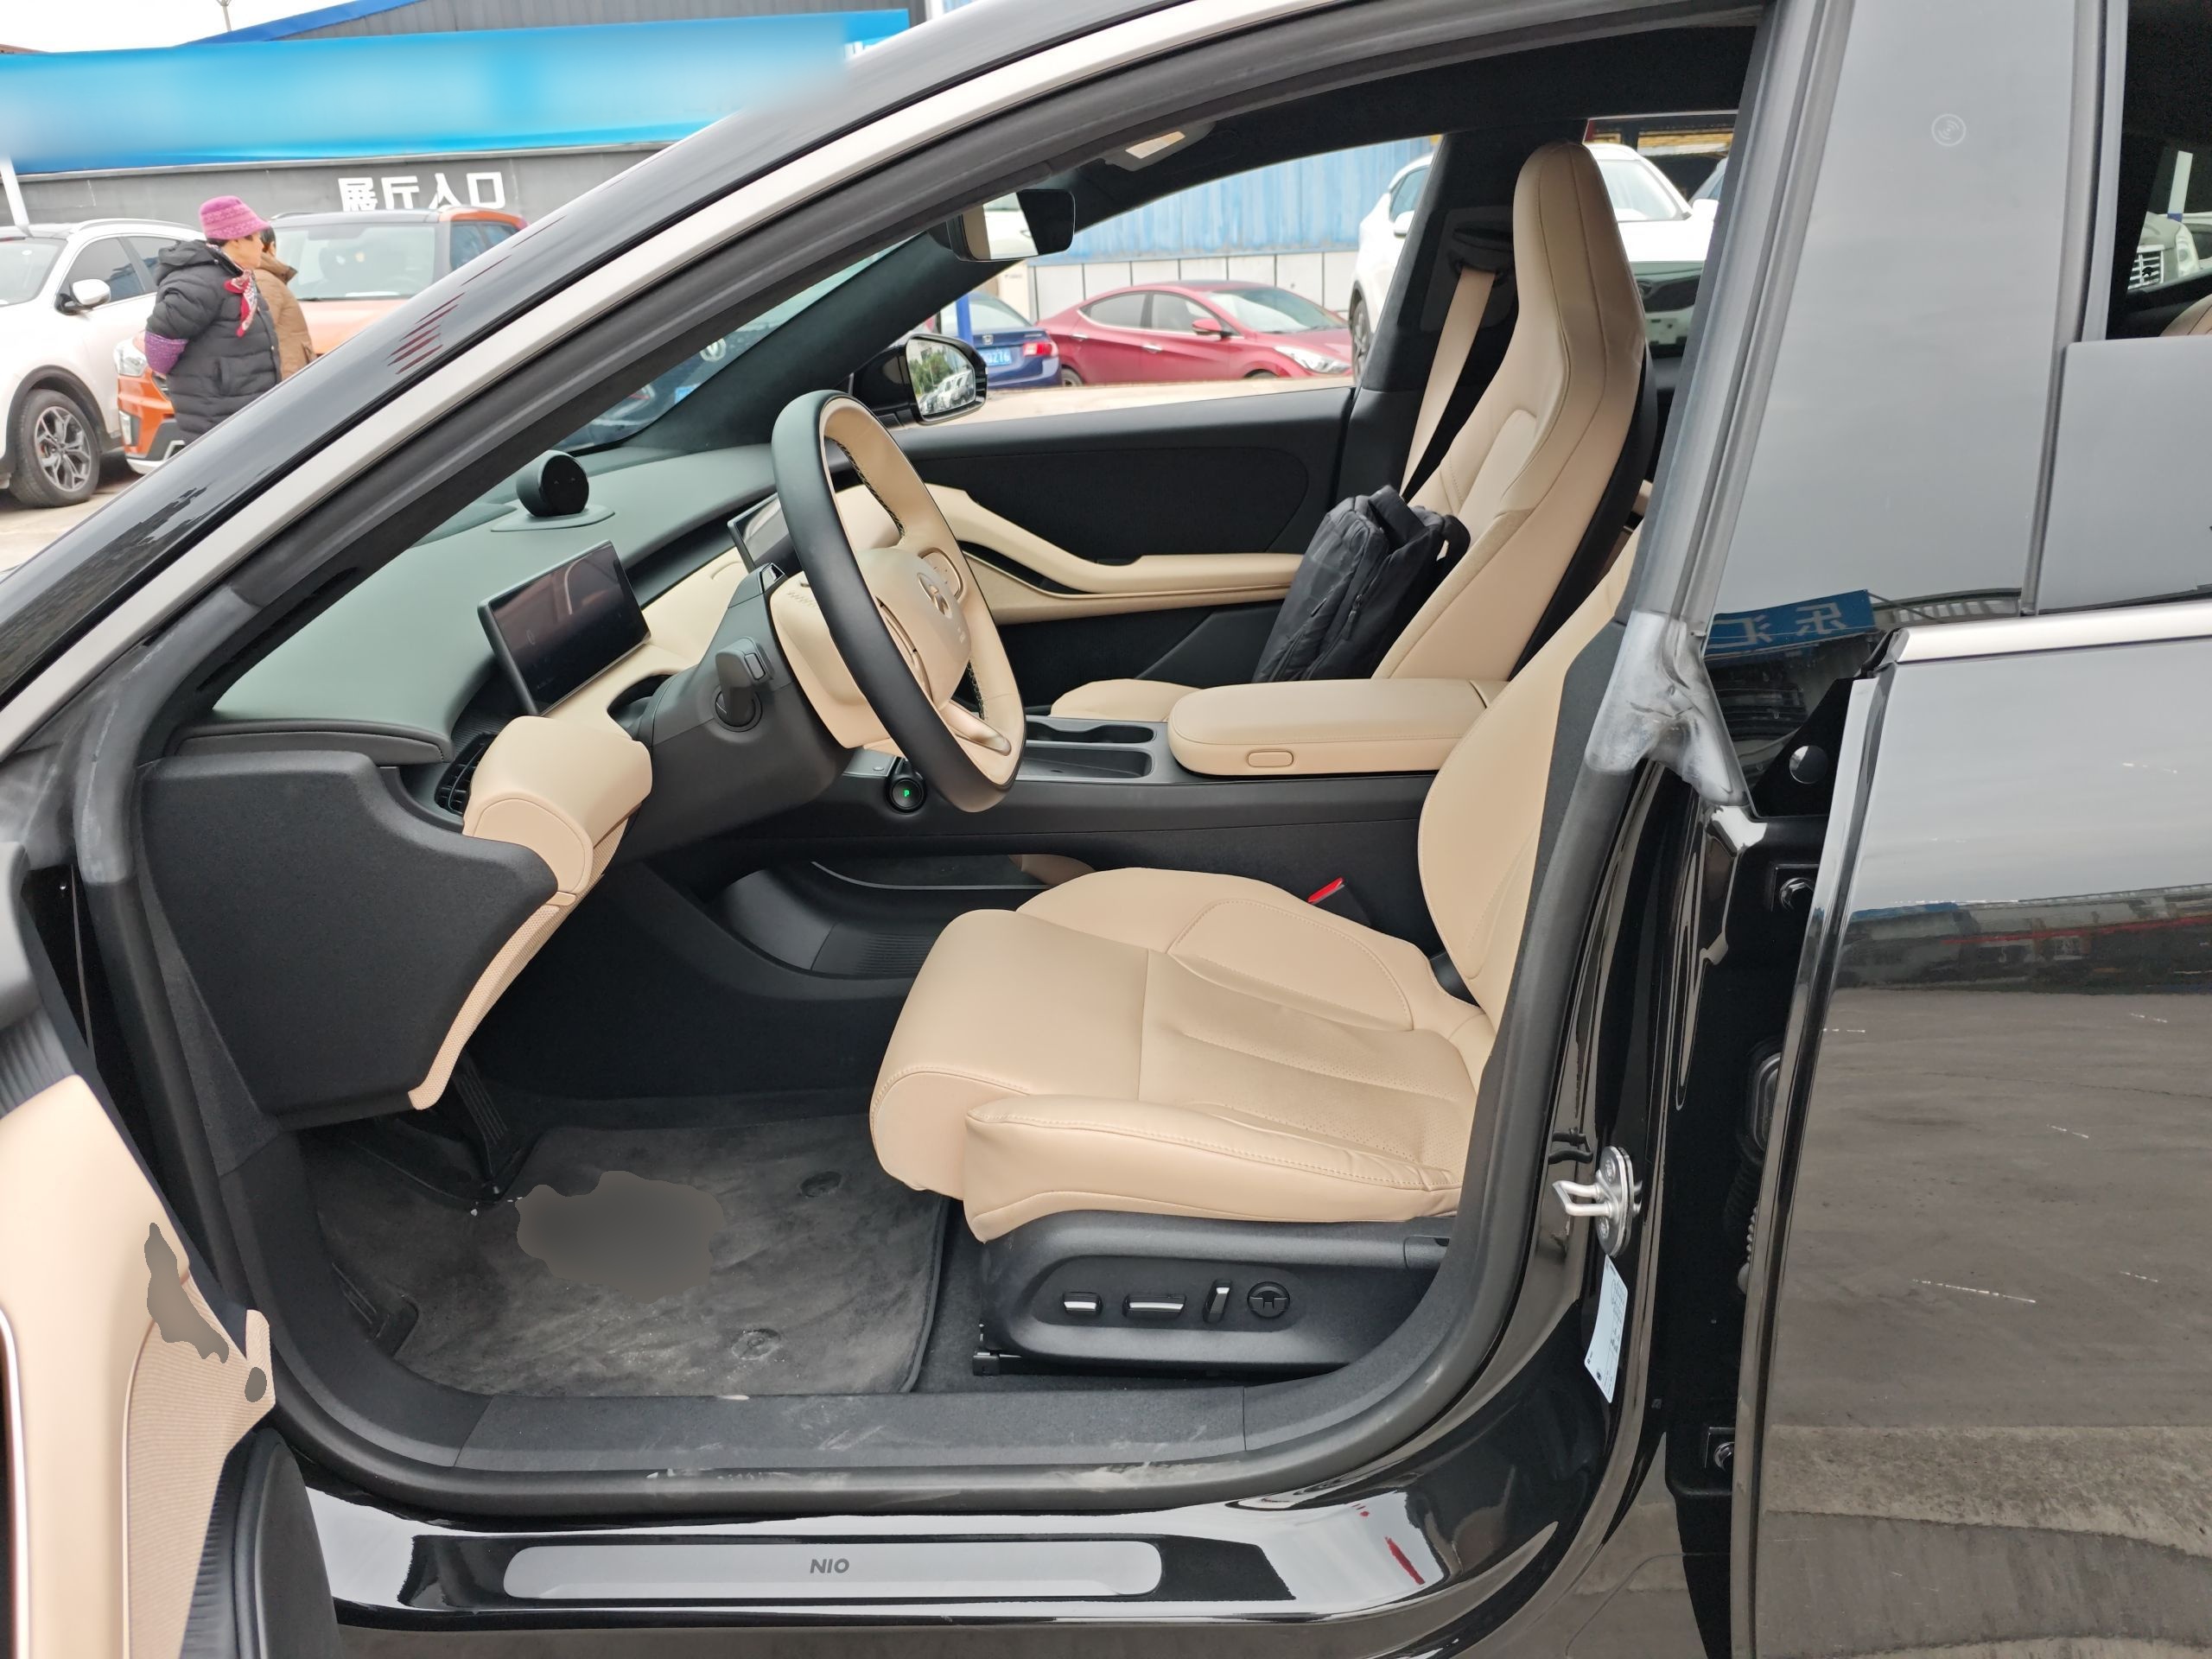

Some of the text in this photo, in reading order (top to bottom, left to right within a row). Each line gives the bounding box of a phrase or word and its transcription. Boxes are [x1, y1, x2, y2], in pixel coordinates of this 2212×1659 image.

[338, 172, 505, 212] 展厅入口
[810, 1558, 849, 1573] NIO
